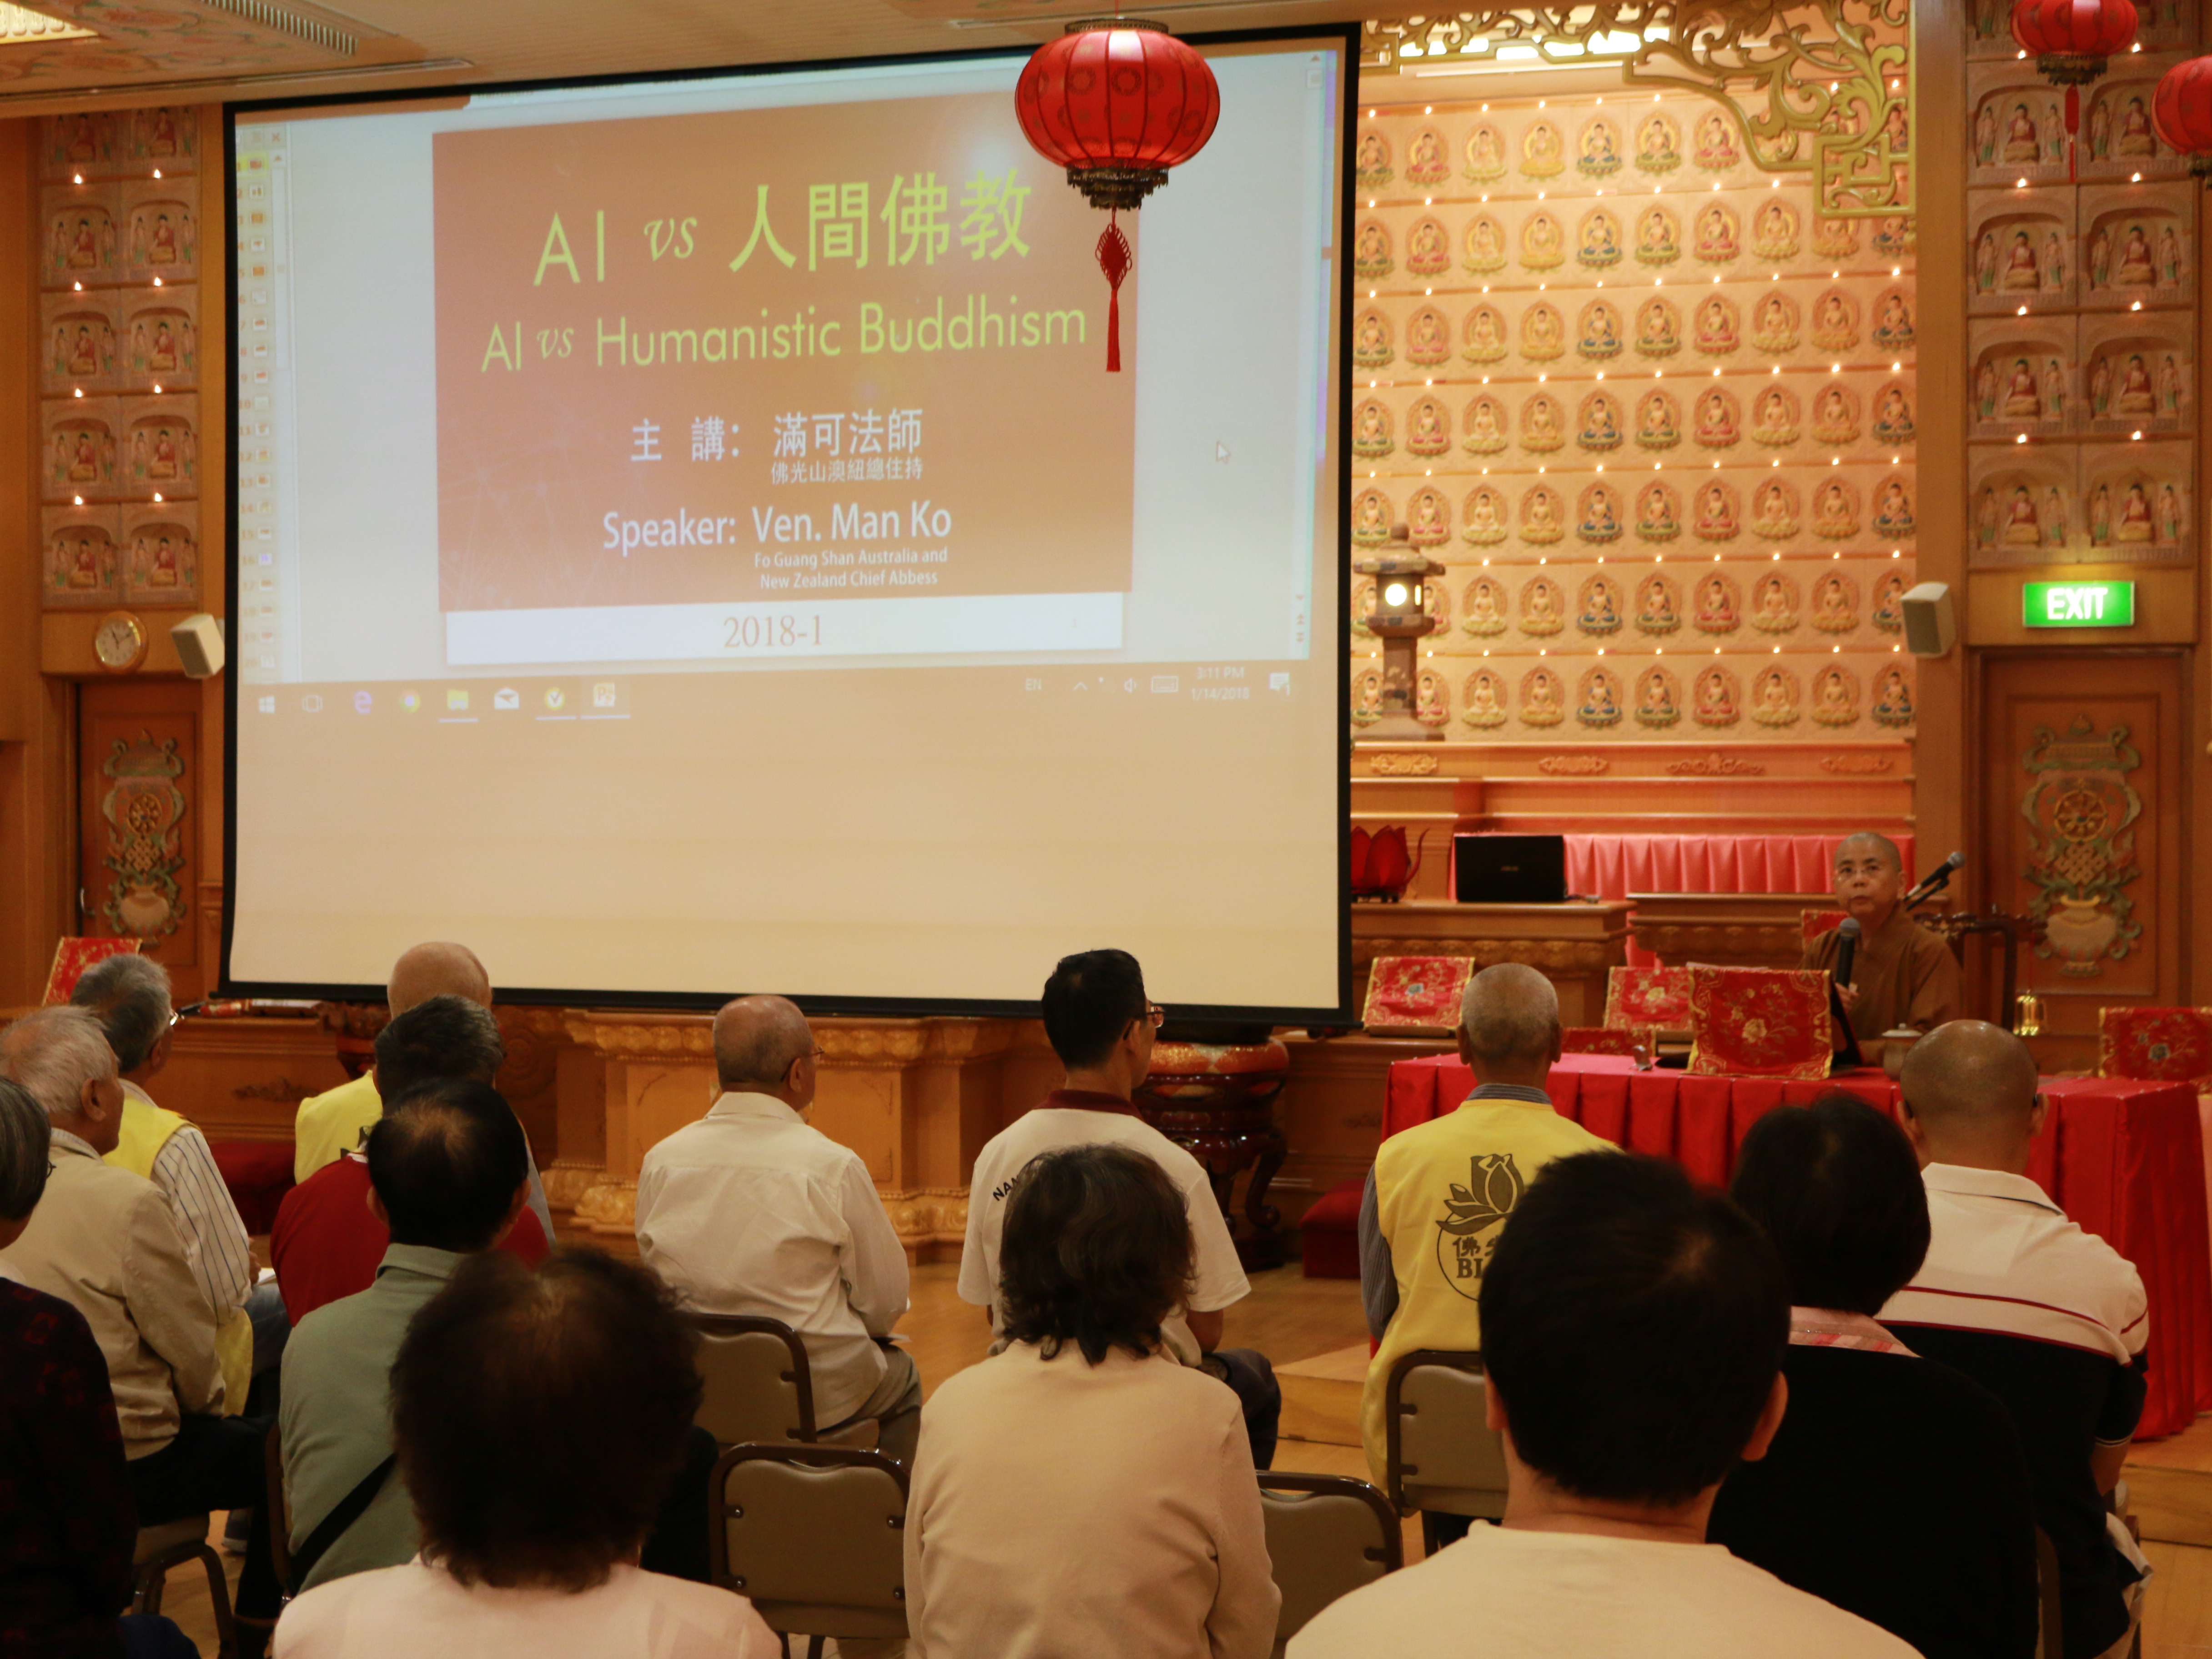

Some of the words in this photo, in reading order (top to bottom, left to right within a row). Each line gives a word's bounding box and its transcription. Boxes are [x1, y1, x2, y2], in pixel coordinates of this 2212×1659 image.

[533, 210, 605, 286] AI
[643, 216, 698, 261] vs
[729, 168, 1032, 272] 人間佛教
[481, 321, 522, 372] AI
[537, 327, 575, 359] vs
[597, 305, 842, 366] Humanistic
[860, 293, 1086, 354] Buddhism
[630, 418, 663, 462] 主
[773, 409, 923, 457] 滿可法師
[603, 508, 735, 558] Speaker:
[751, 506, 822, 543] Ven.
[831, 503, 900, 540] Man
[910, 500, 952, 538] Ko
[754, 552, 772, 568] Fo
[773, 552, 818, 572] Guang
[821, 551, 855, 567] Shan
[858, 548, 919, 565] Australia
[920, 547, 948, 563] and
[760, 574, 790, 589] New
[793, 572, 847, 589] Zealand
[850, 570, 886, 587] Chief
[888, 569, 939, 586] Abbess
[2047, 587, 2108, 619] EXIT
[724, 614, 821, 648] 2018-1
[1025, 679, 1042, 691] EN
[1197, 667, 1219, 679] 3:11
[1224, 667, 1245, 679] PM
[1191, 687, 1250, 701] 1/14/2018
